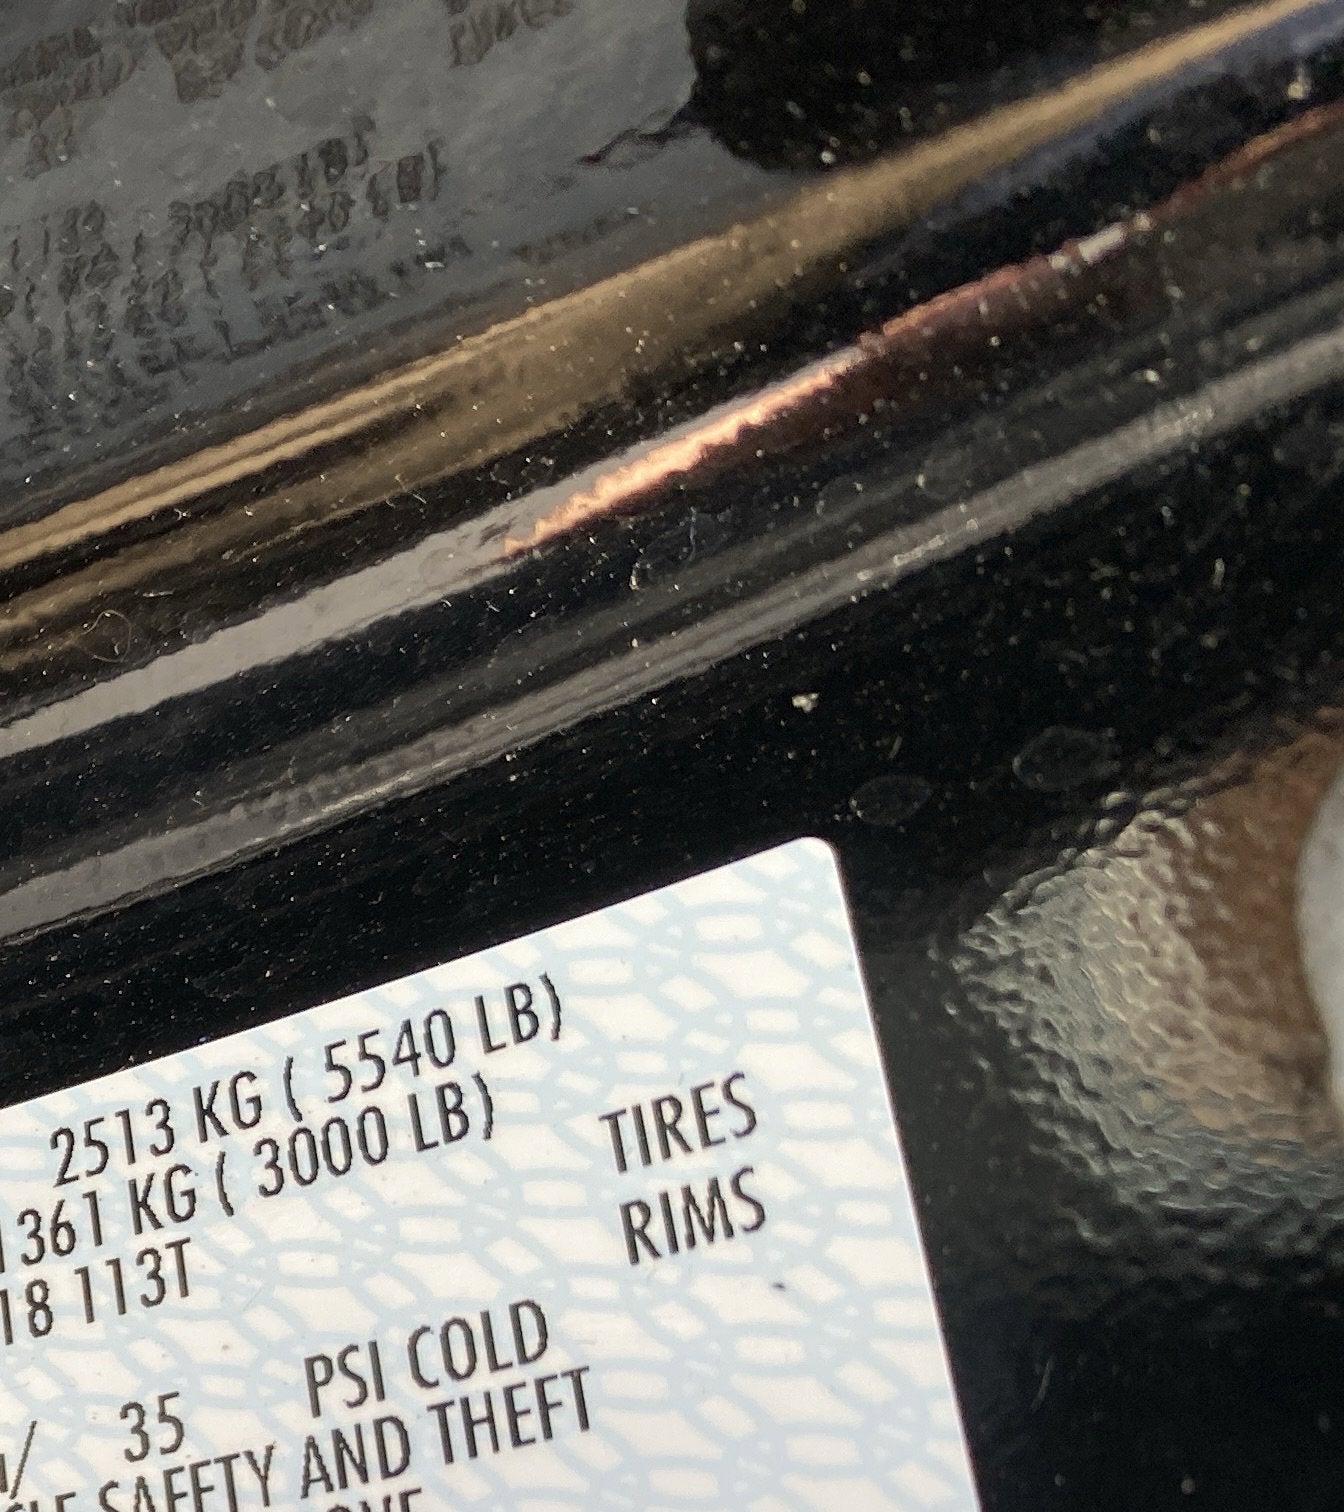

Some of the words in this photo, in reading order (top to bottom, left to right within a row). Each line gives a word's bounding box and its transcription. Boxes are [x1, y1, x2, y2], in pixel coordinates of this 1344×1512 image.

[50, 1099, 175, 1187] 2513
[193, 1071, 263, 1142] KG
[324, 1008, 456, 1102] 5540
[475, 972, 562, 1056] LB)
[127, 1164, 197, 1237] KG
[254, 1106, 389, 1198] 3000
[407, 1072, 494, 1152] LB)
[75, 1237, 192, 1323] 113T
[599, 1071, 757, 1173] TIRES
[620, 1166, 766, 1265] RIMS
[120, 1392, 184, 1463] 35
[304, 1340, 385, 1418] PSI
[407, 1299, 549, 1390] COLD
[300, 1417, 411, 1499] AND
[427, 1366, 590, 1464] THEFT
